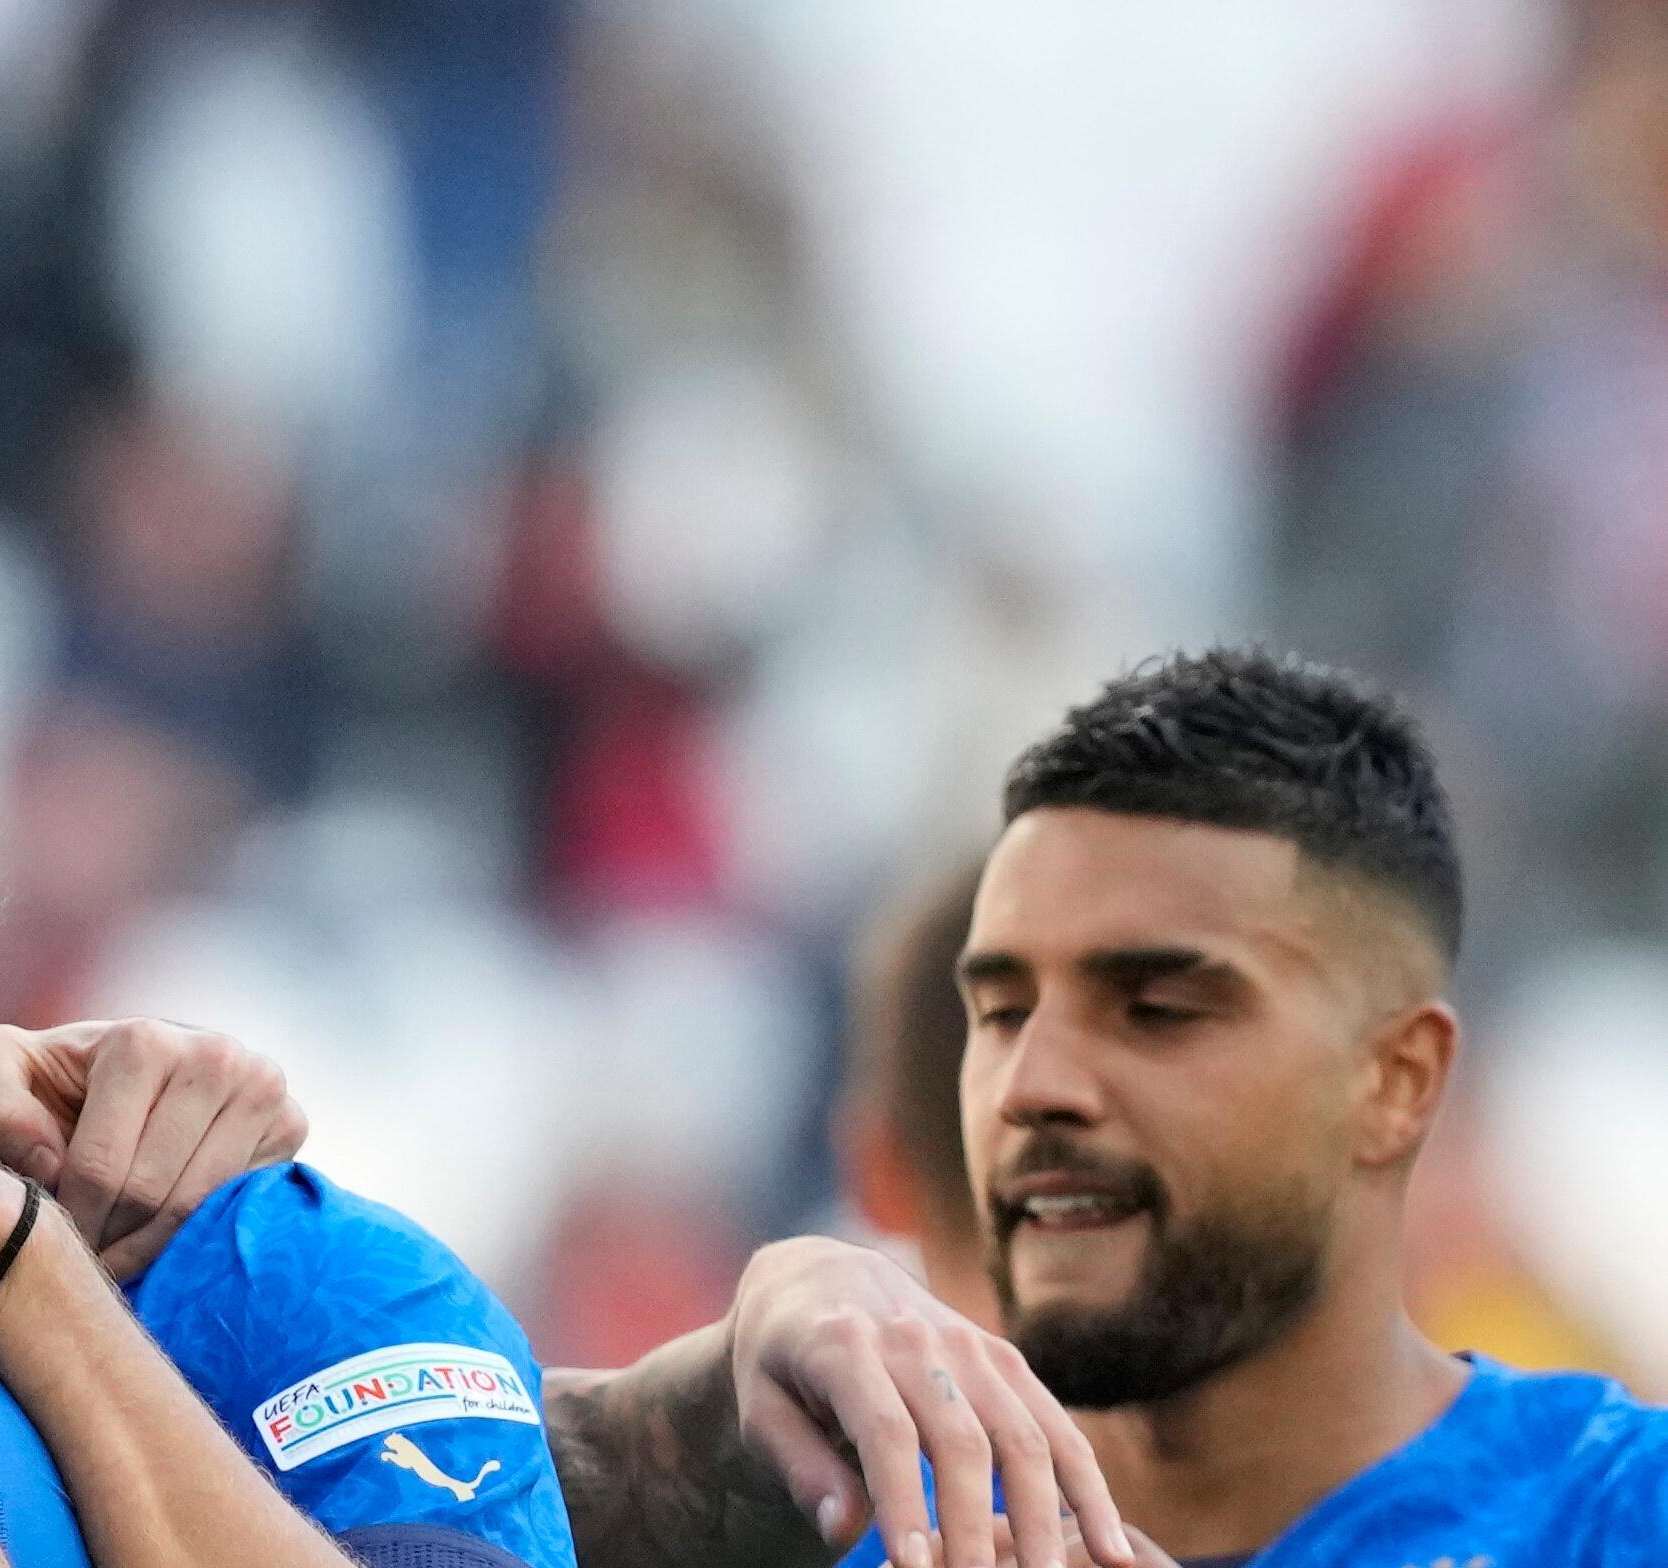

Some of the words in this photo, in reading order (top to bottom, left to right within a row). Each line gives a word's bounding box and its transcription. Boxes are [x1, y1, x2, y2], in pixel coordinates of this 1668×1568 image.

[264, 1383, 320, 1421] UEFA
[270, 1367, 522, 1444] FOUNDATION
[484, 1398, 531, 1414] children
